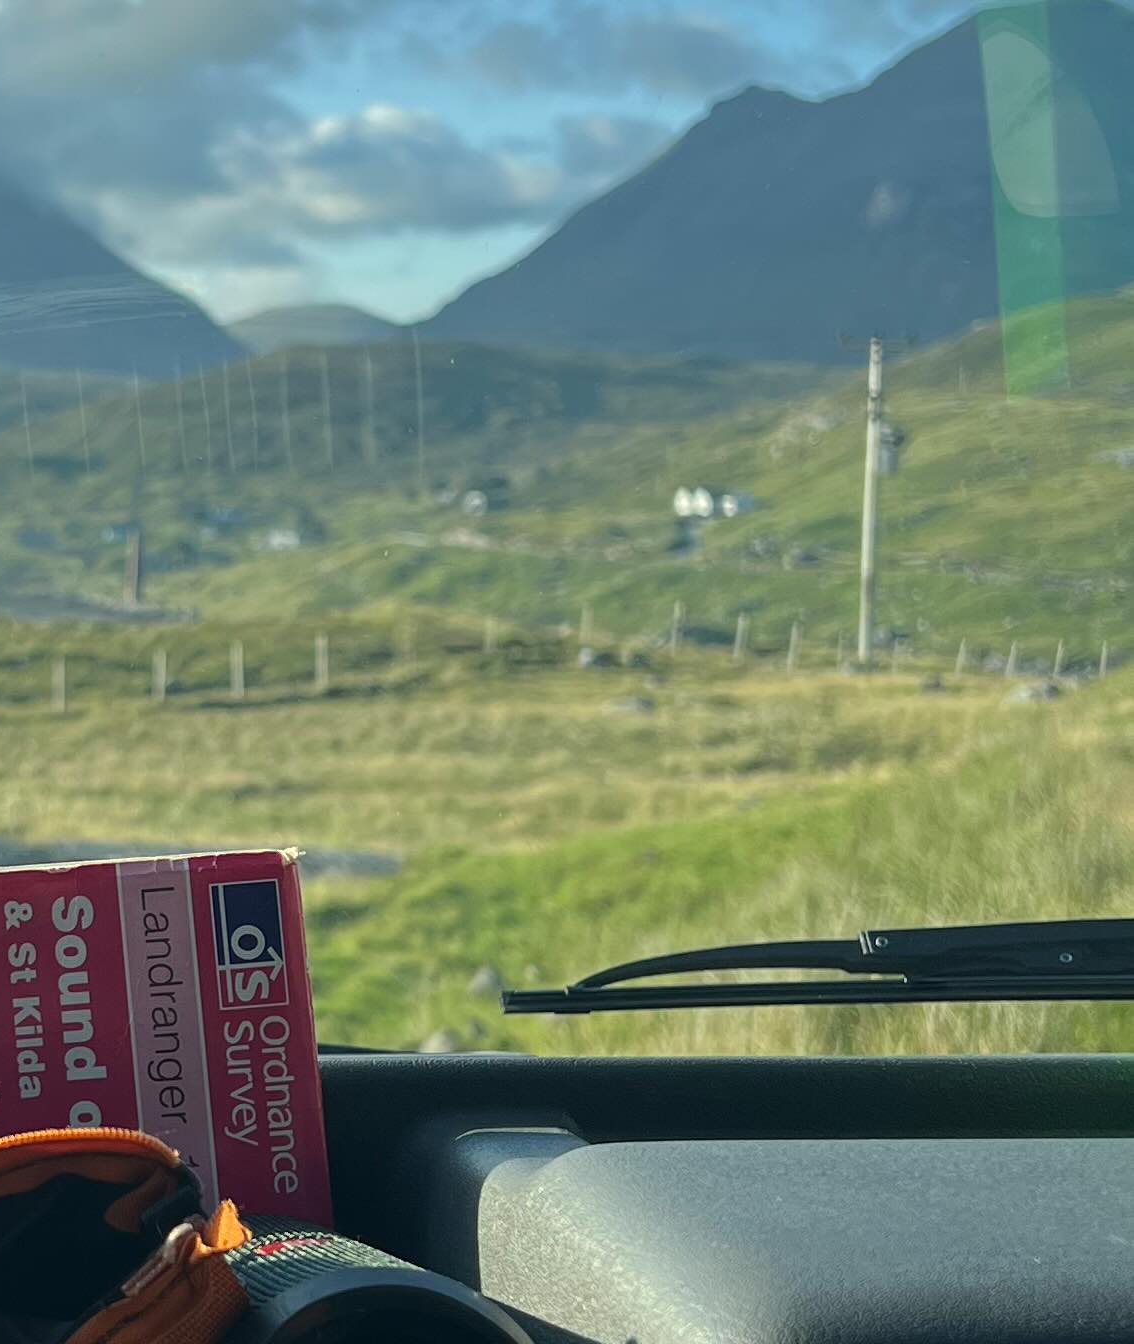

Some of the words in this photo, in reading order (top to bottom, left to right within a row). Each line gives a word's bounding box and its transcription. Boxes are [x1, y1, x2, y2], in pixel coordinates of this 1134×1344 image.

[4, 901, 33, 928] &
[7, 943, 37, 983] St
[51, 895, 108, 1081] Sound
[140, 885, 188, 1125] Landranger
[12, 997, 47, 1099] Kilda
[222, 1021, 258, 1146] Survey
[68, 1099, 101, 1129] o
[258, 1015, 300, 1195] Ordnance
